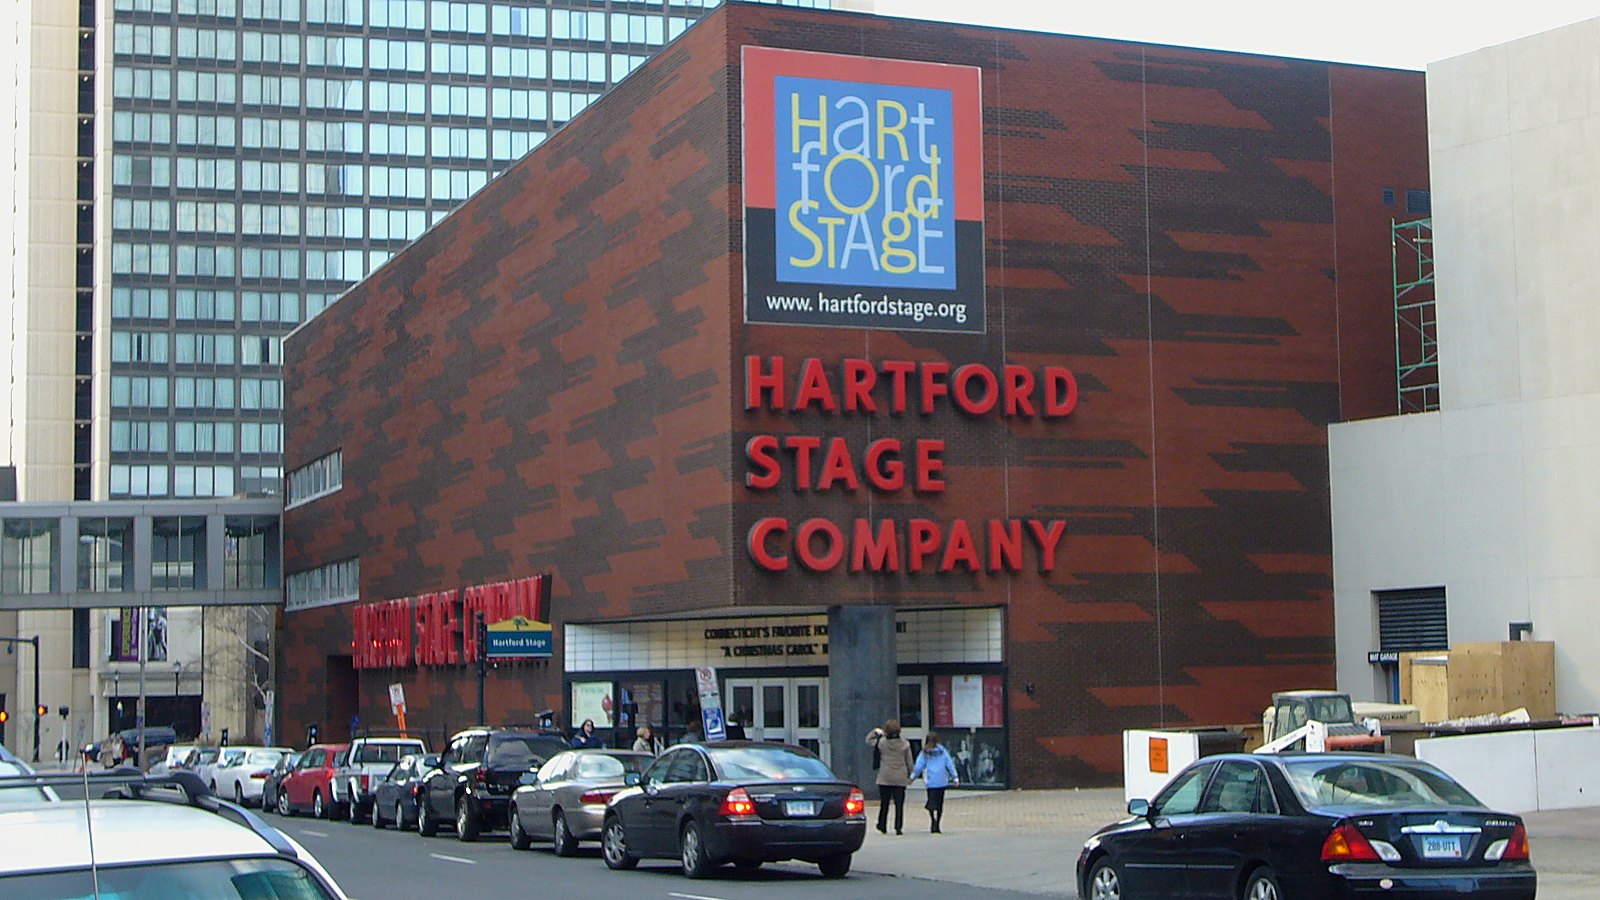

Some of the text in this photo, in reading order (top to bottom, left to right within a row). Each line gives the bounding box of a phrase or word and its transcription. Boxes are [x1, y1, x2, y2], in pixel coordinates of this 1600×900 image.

[766, 291, 967, 323] www. hartfordstage.org
[745, 354, 1078, 418] HARTFORD
[746, 434, 946, 493] STAGE
[749, 516, 1067, 573] COMPANY
[493, 637, 546, 648] Hartford Stage
[733, 644, 783, 657] CHRISTMAS
